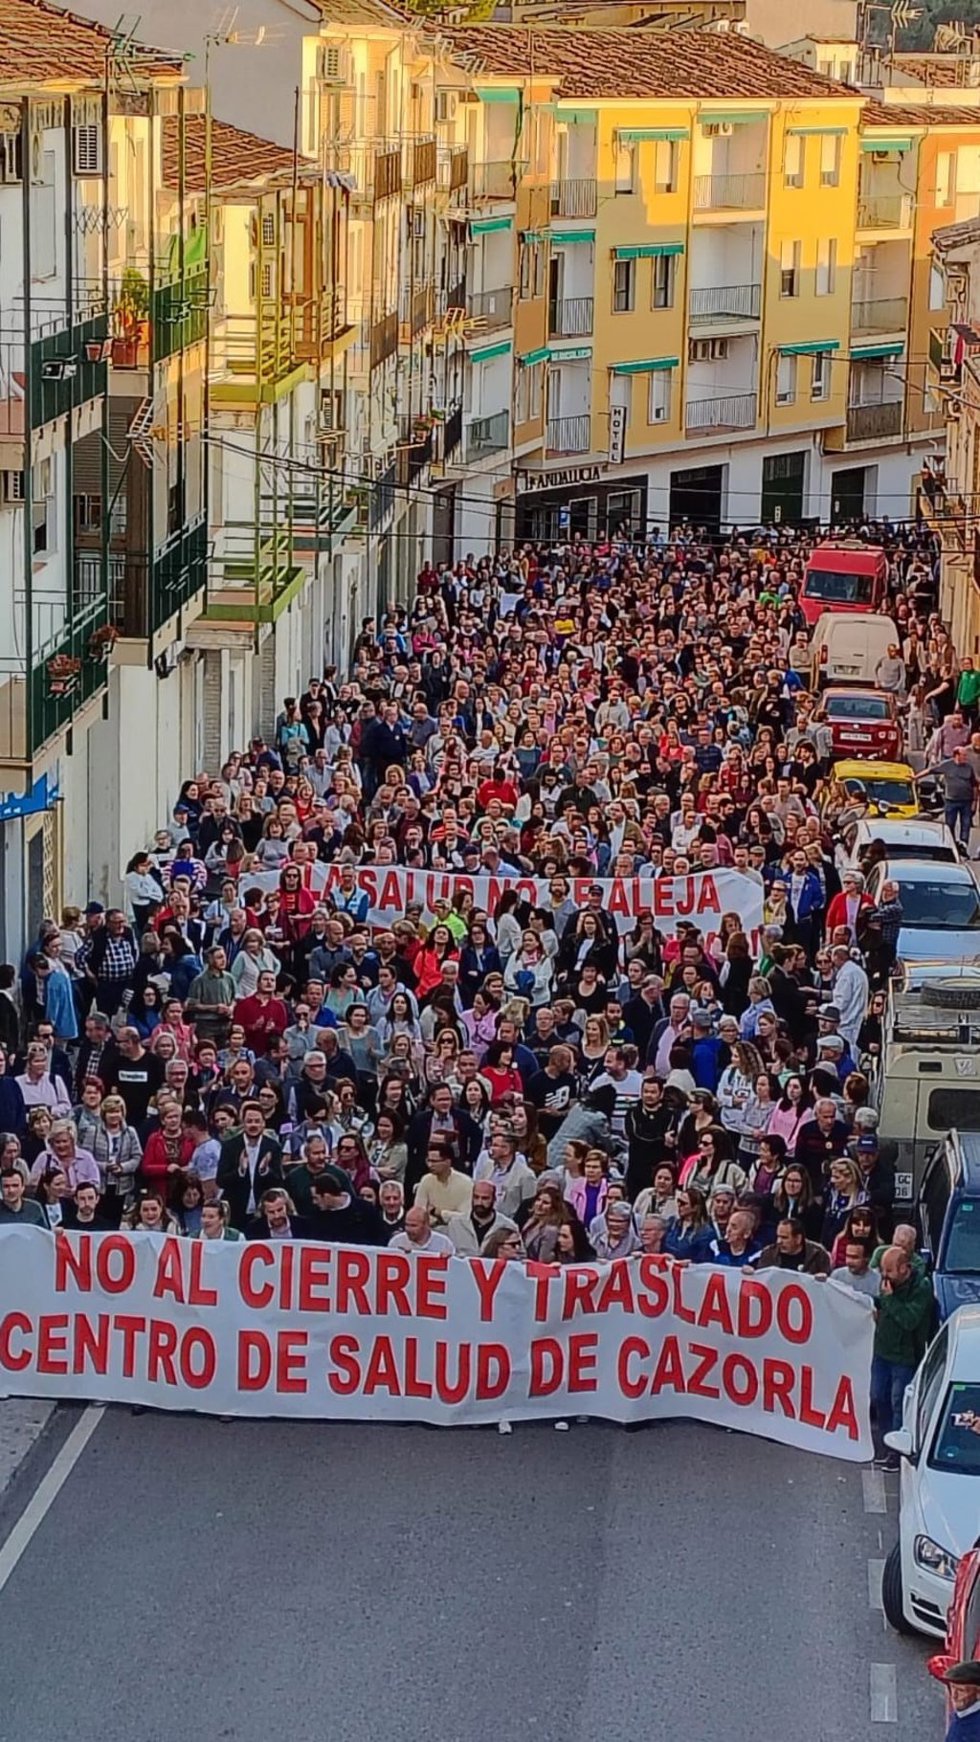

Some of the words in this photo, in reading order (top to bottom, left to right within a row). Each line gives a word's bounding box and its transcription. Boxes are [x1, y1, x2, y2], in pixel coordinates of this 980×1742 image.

[611, 408, 621, 462] HOTEL
[609, 874, 721, 917] ALEJA
[55, 1234, 135, 1294] NO
[153, 1237, 217, 1306] AL
[239, 1243, 448, 1320] CIERRE
[470, 1259, 505, 1322] Y
[526, 1253, 813, 1345] TRASLADO
[1, 1312, 216, 1390] CENTRO
[238, 1330, 308, 1394] DE
[328, 1335, 511, 1405] SALUD
[529, 1333, 598, 1397] DE
[617, 1335, 859, 1441] CAZORLA
